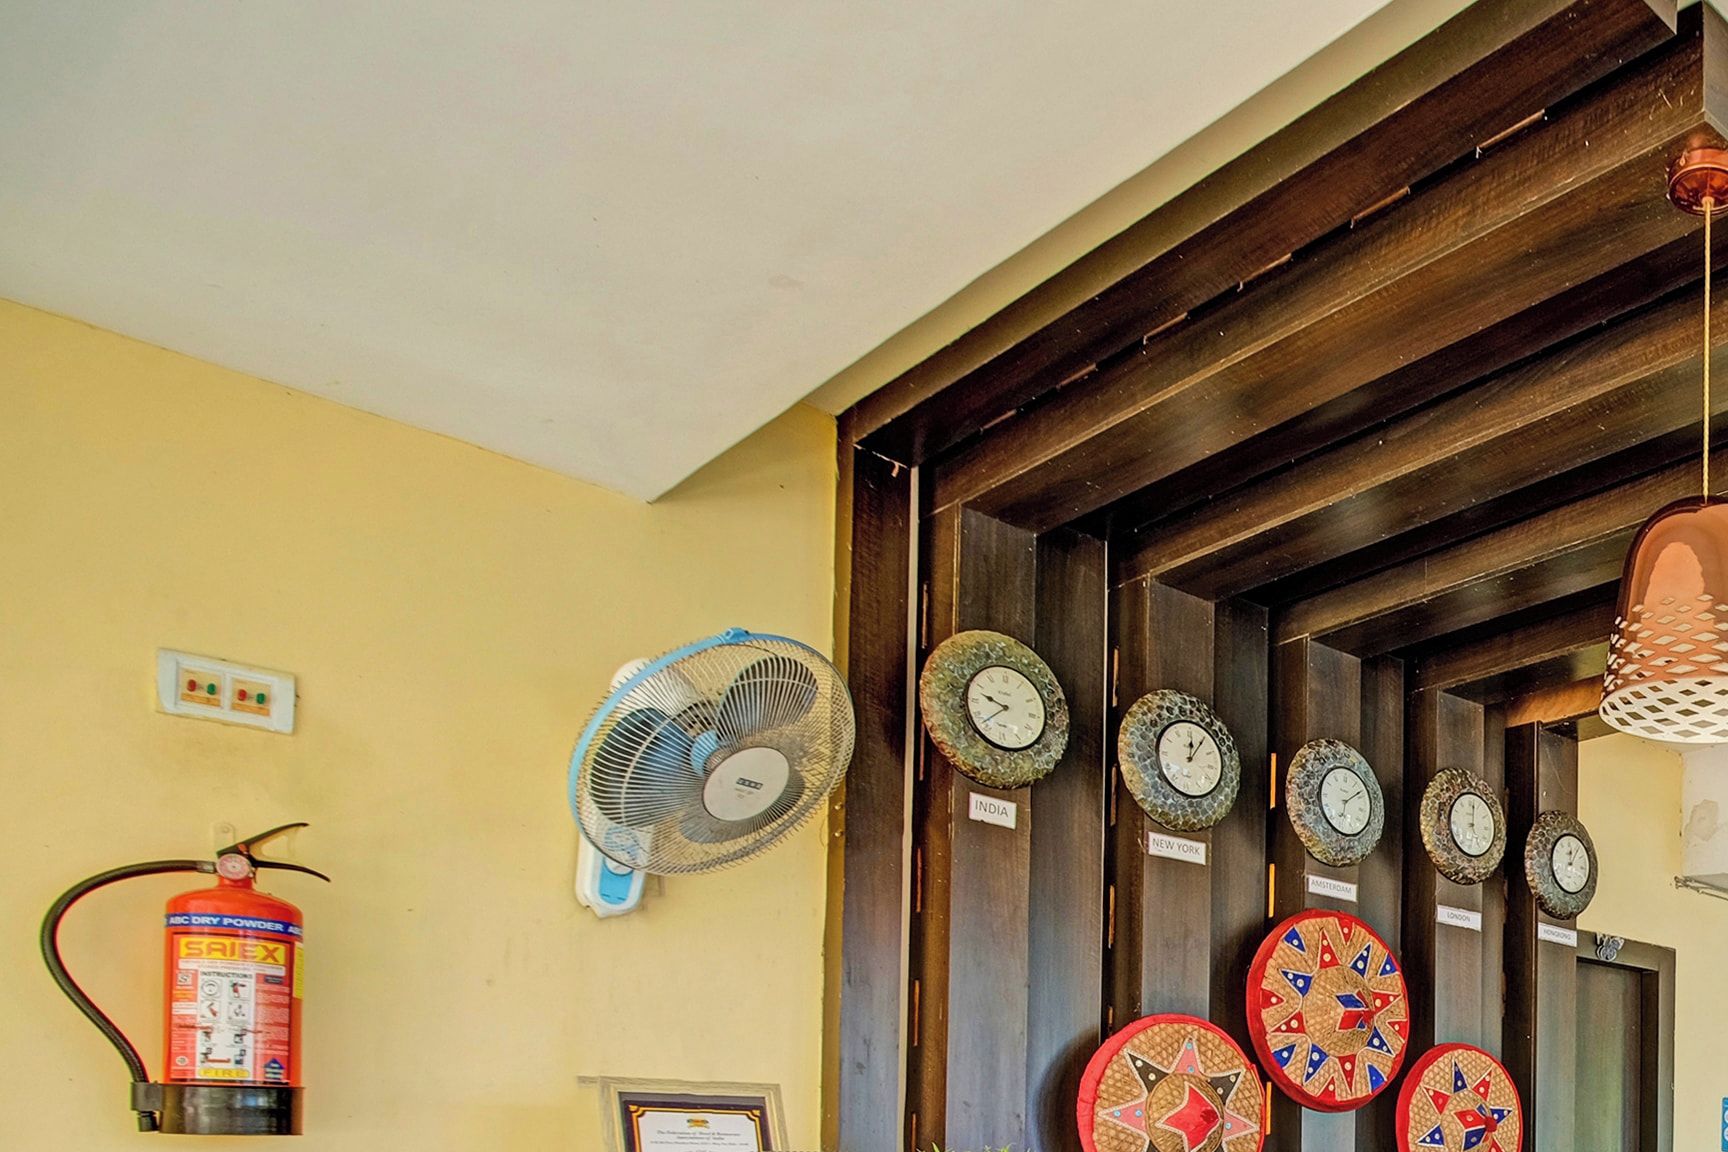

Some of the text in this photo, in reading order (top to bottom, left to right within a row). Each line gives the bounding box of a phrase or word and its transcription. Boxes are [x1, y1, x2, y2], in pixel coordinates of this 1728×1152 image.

[975, 799, 1009, 818] INDIA
[1152, 838, 1200, 855] NEW YORK
[1311, 878, 1352, 894] AMSTERDAM
[170, 916, 189, 924] ABC
[191, 916, 220, 925] DRY
[223, 917, 284, 931] POWDER
[1447, 911, 1470, 923] LONDON
[200, 971, 253, 979] INSTRUCTIONS
